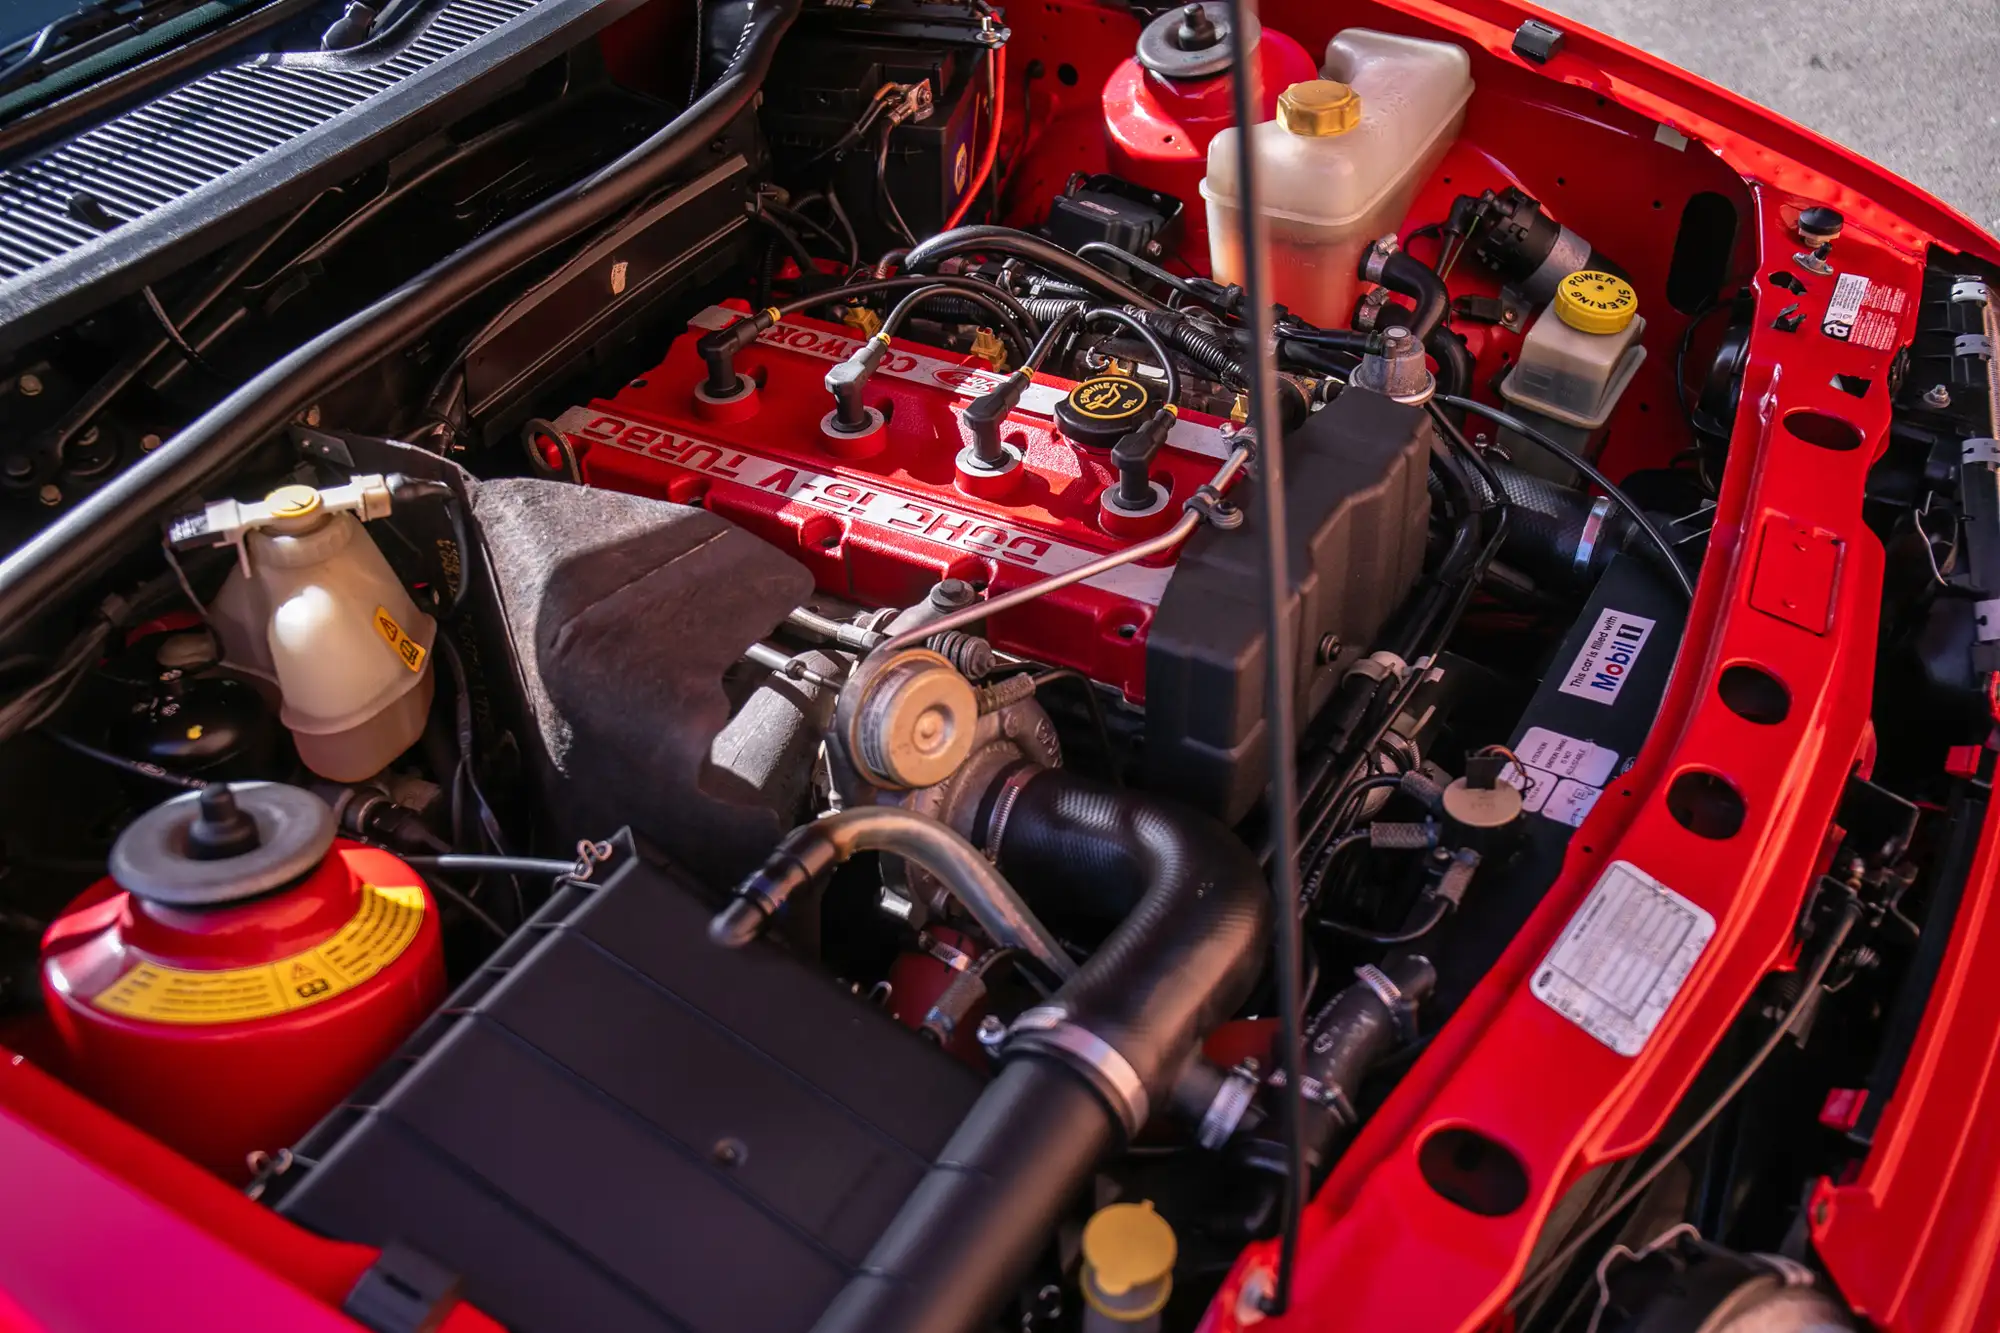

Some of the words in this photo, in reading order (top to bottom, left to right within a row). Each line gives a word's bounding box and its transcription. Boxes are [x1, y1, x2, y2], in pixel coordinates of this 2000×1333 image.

[1568, 273, 1617, 287] POWER
[1571, 289, 1632, 310] STEERING
[1080, 382, 1111, 404] ENGINE
[1122, 398, 1138, 409] OIL
[582, 416, 748, 479] TURBO
[888, 502, 1052, 568] DOHC
[1603, 616, 1618, 631] with
[1591, 631, 1609, 651] filled
[1586, 650, 1598, 658] is
[1582, 658, 1594, 672] car
[1590, 641, 1637, 692] Mobil
[1570, 672, 1586, 688] This
